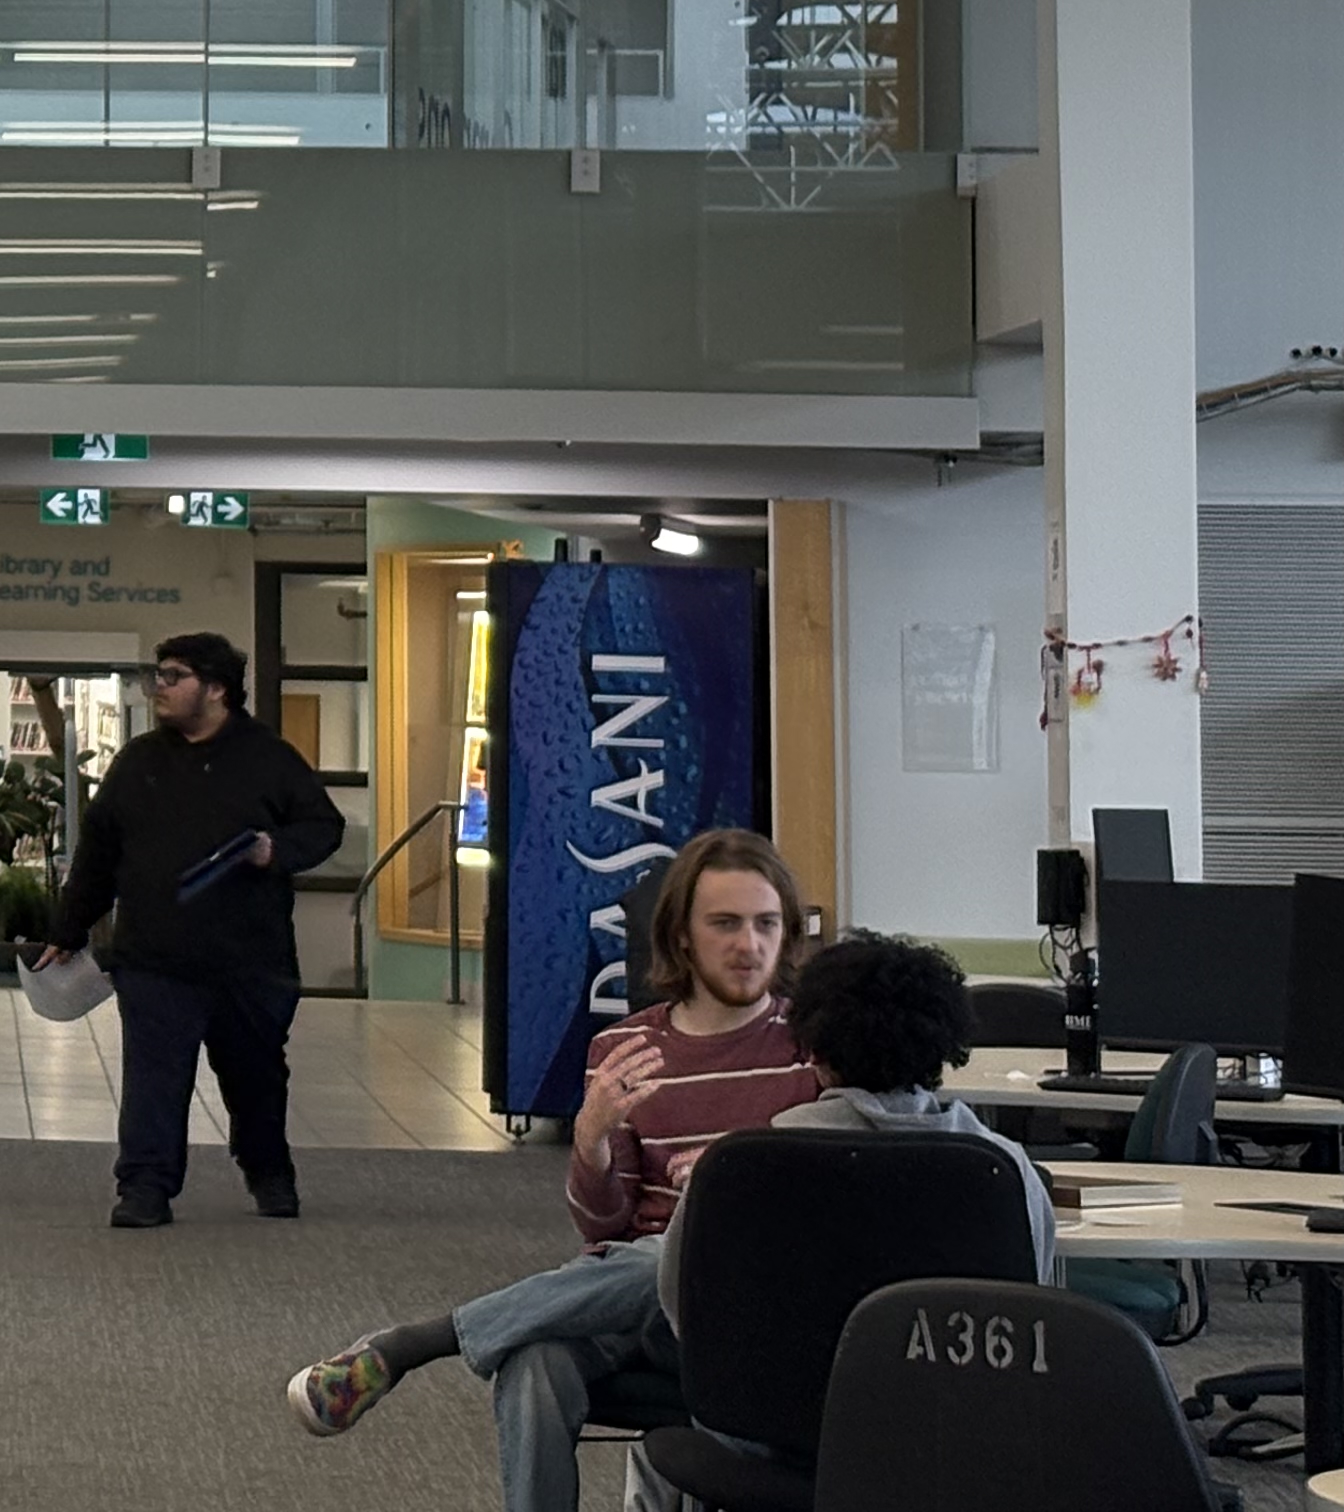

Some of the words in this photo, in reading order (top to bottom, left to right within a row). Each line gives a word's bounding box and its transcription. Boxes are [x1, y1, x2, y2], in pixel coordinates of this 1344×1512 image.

[69, 555, 111, 577] and
[87, 581, 181, 604] Services
[906, 1308, 1049, 1374] A361
